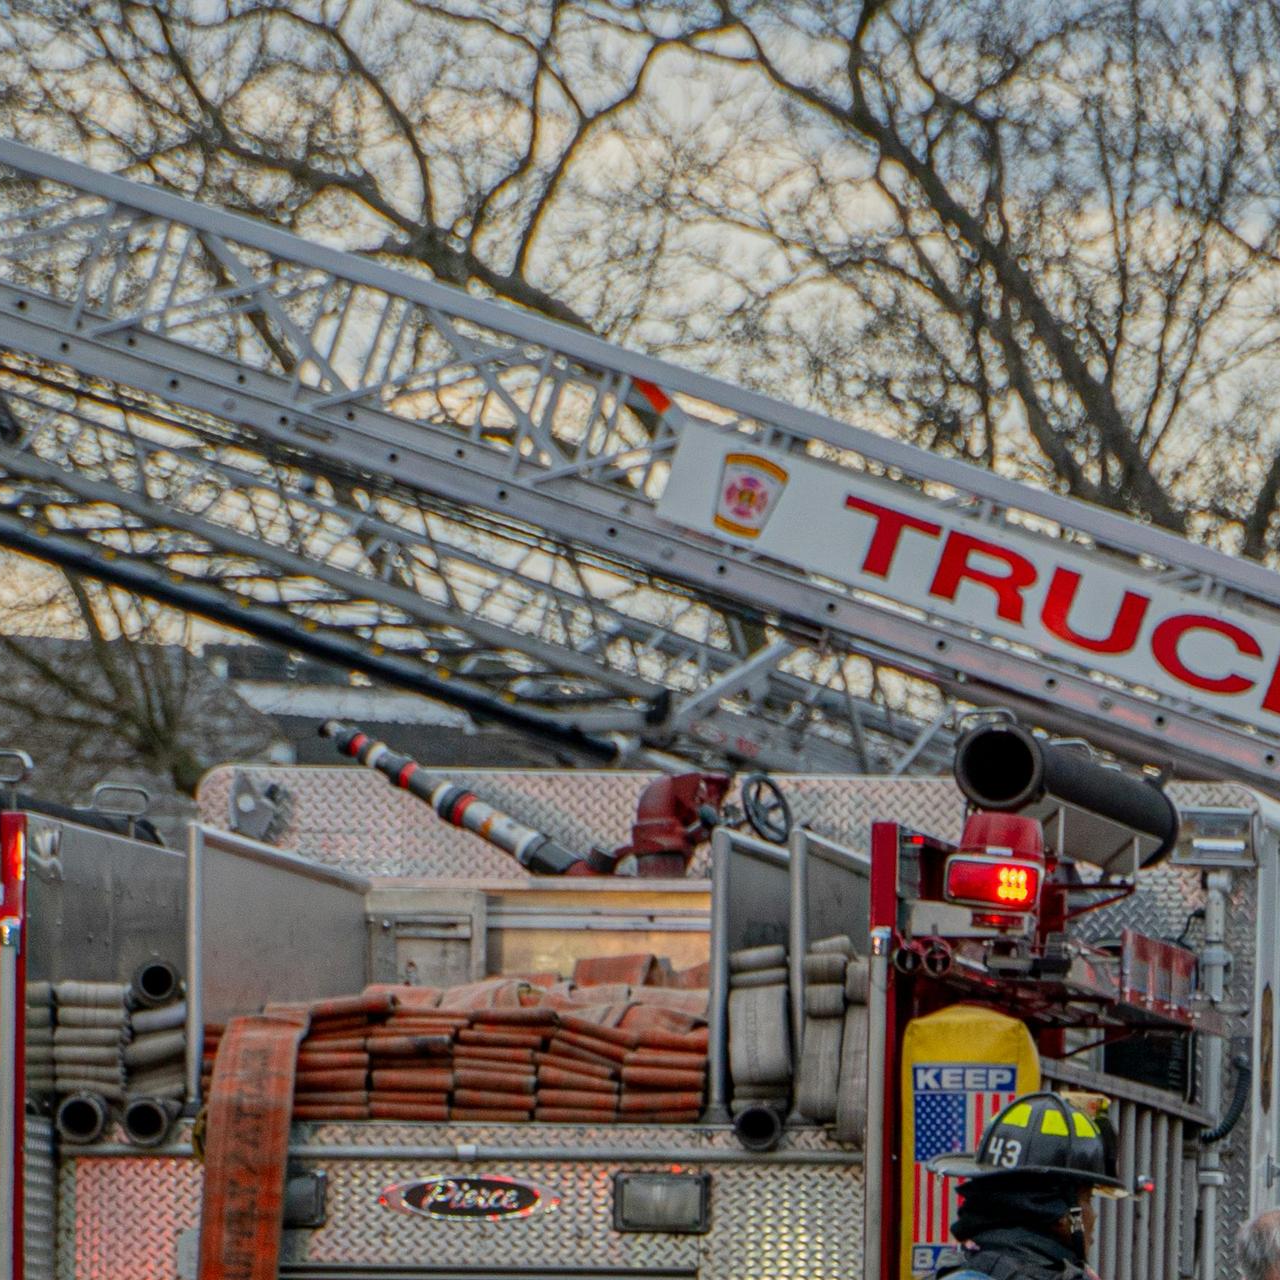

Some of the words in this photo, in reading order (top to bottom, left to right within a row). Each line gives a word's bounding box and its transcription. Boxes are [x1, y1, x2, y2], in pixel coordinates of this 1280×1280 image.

[917, 1068, 1013, 1091] KEEP
[988, 1136, 1022, 1167] 43
[421, 1180, 519, 1209] Pierce
